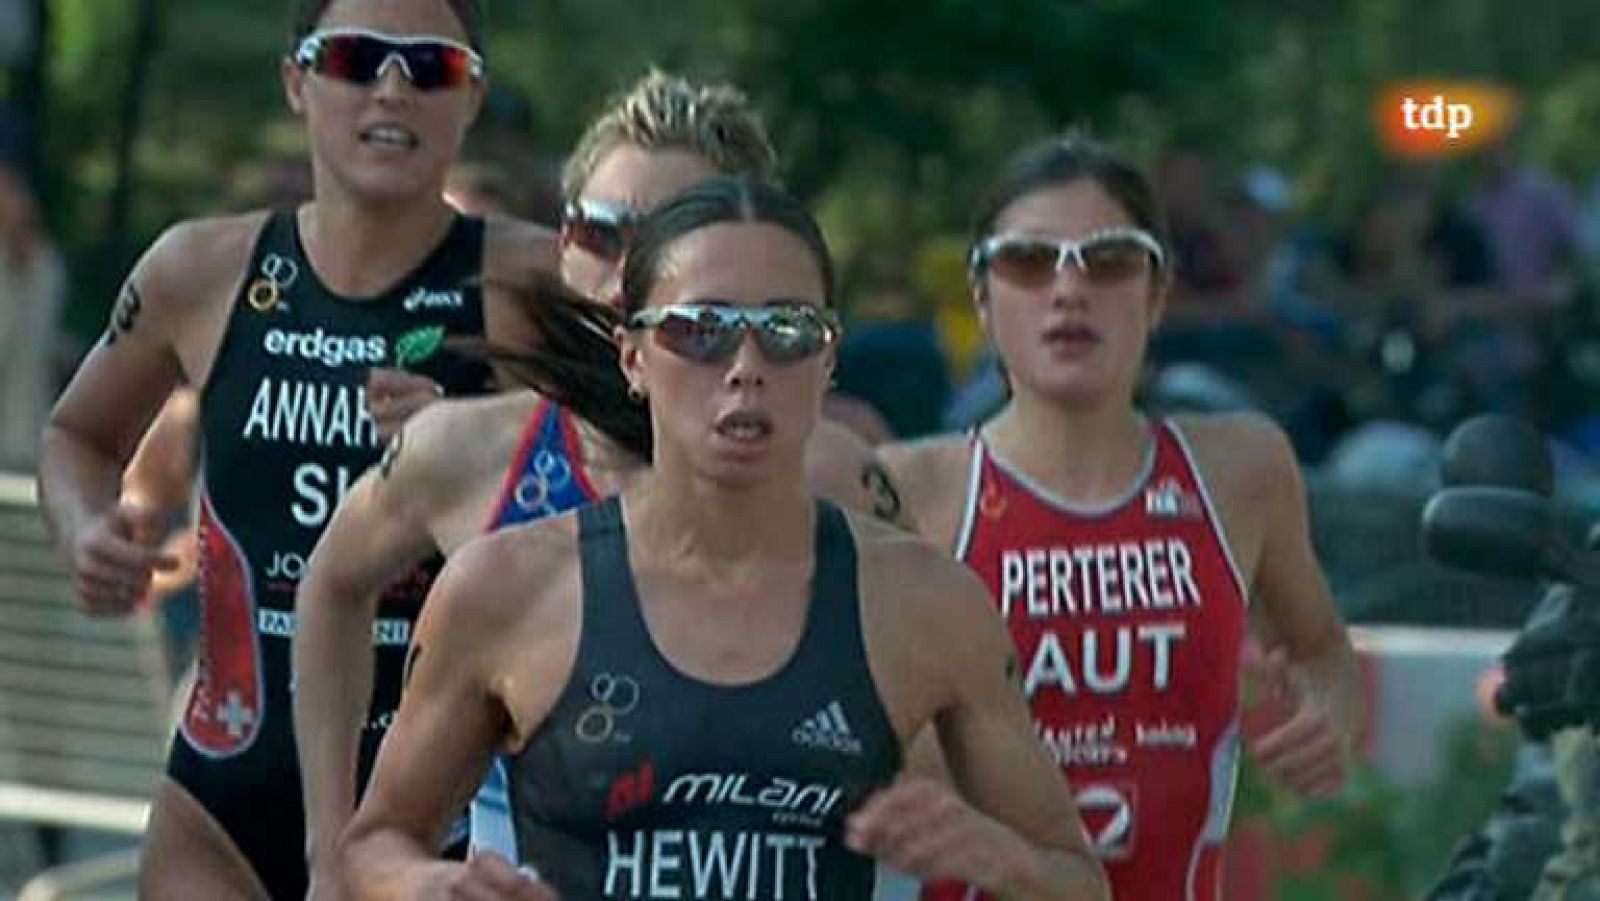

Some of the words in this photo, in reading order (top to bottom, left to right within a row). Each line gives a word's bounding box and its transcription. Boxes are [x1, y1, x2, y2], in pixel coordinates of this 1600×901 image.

[264, 328, 387, 367] erdgas
[1001, 537, 1202, 619] PERTERER
[1024, 622, 1187, 697] AUT
[602, 830, 827, 901] HEWITT
